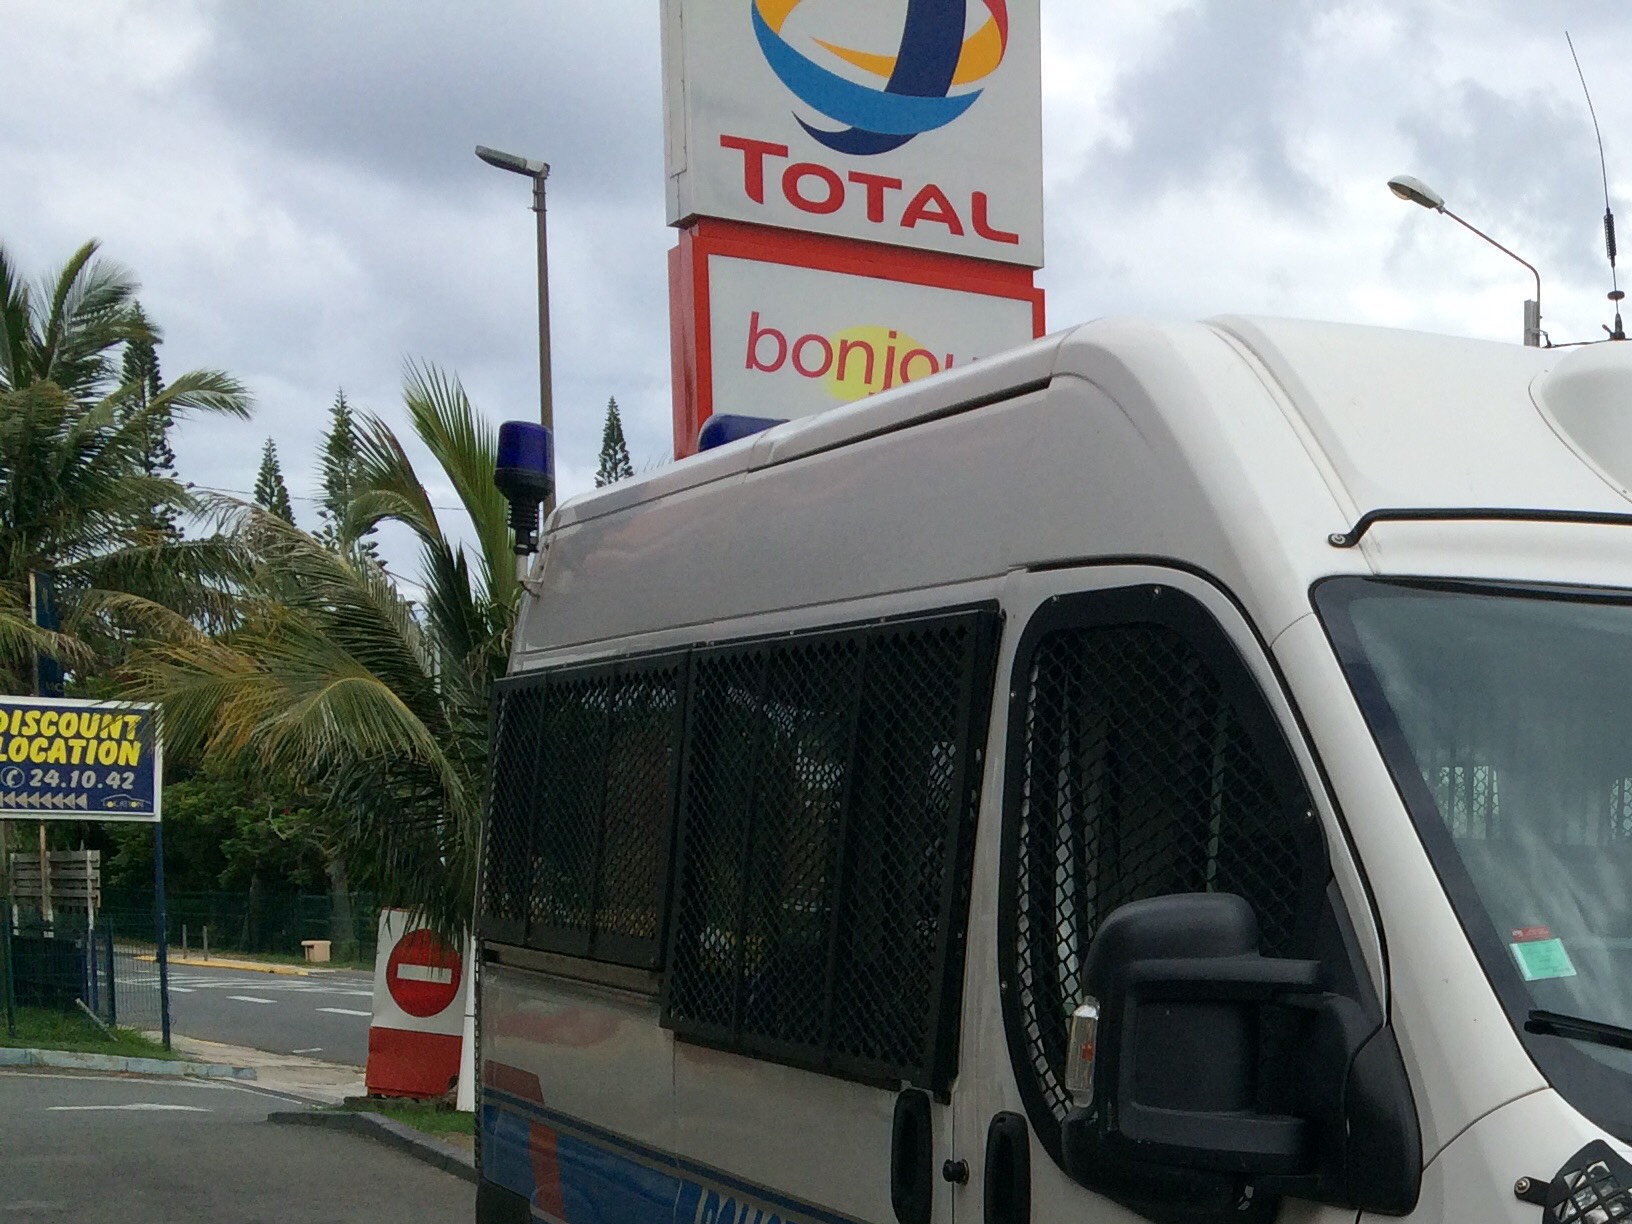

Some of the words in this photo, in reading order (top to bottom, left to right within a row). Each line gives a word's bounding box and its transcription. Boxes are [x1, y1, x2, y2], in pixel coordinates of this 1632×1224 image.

[720, 134, 1019, 245] TOTAL
[745, 311, 979, 396] bonjo
[29, 768, 135, 790] 24.10.42
